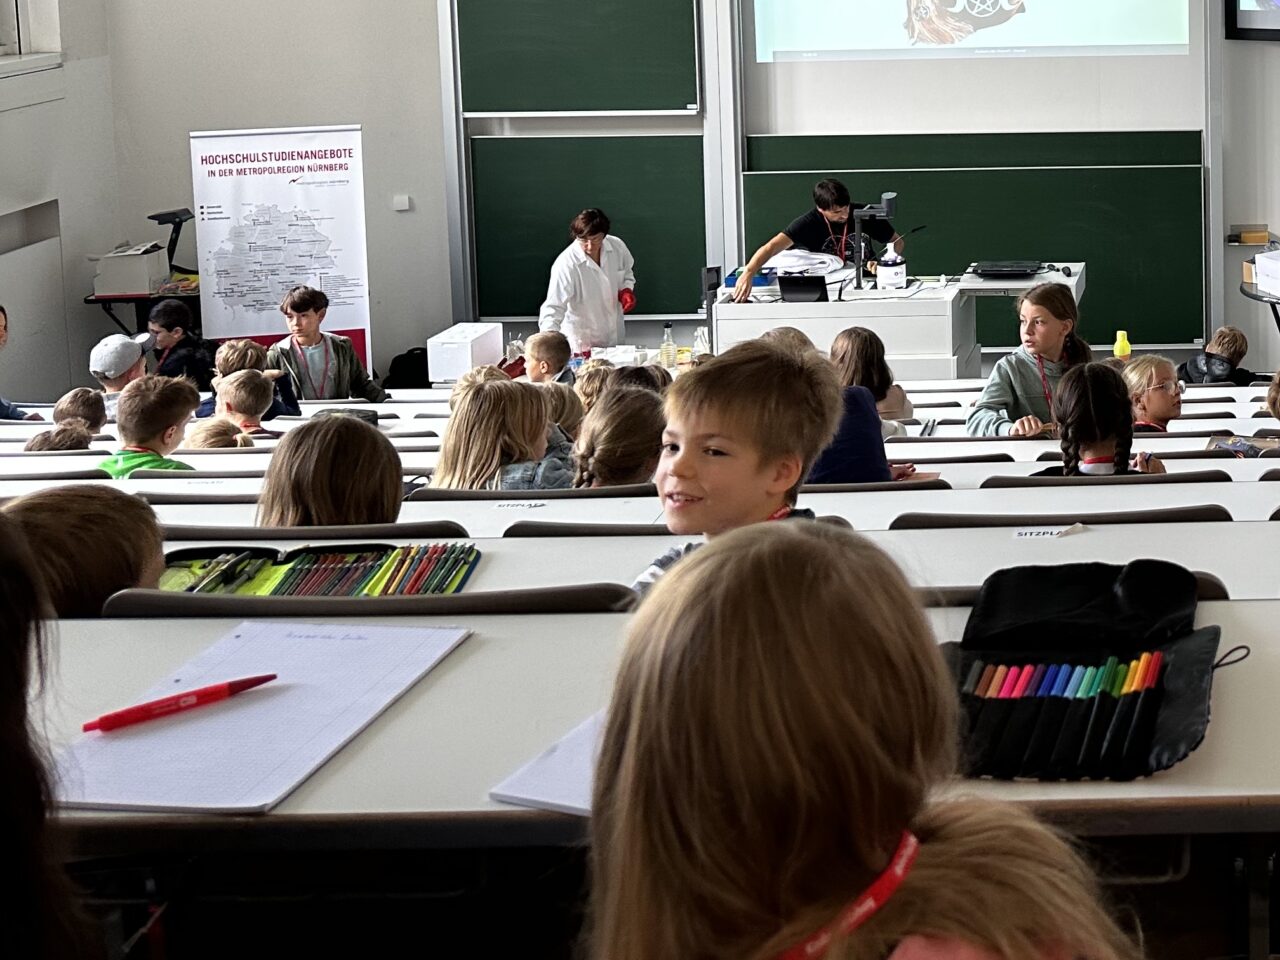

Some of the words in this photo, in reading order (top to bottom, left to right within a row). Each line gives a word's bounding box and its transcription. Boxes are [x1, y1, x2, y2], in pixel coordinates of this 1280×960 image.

[201, 148, 354, 165] HOCHSCHULSTUDIENANGEBOTE
[207, 169, 216, 178] IN
[218, 167, 234, 177] DER
[236, 165, 305, 176] METROPOLREGION
[307, 162, 349, 173] NÜRNBERG
